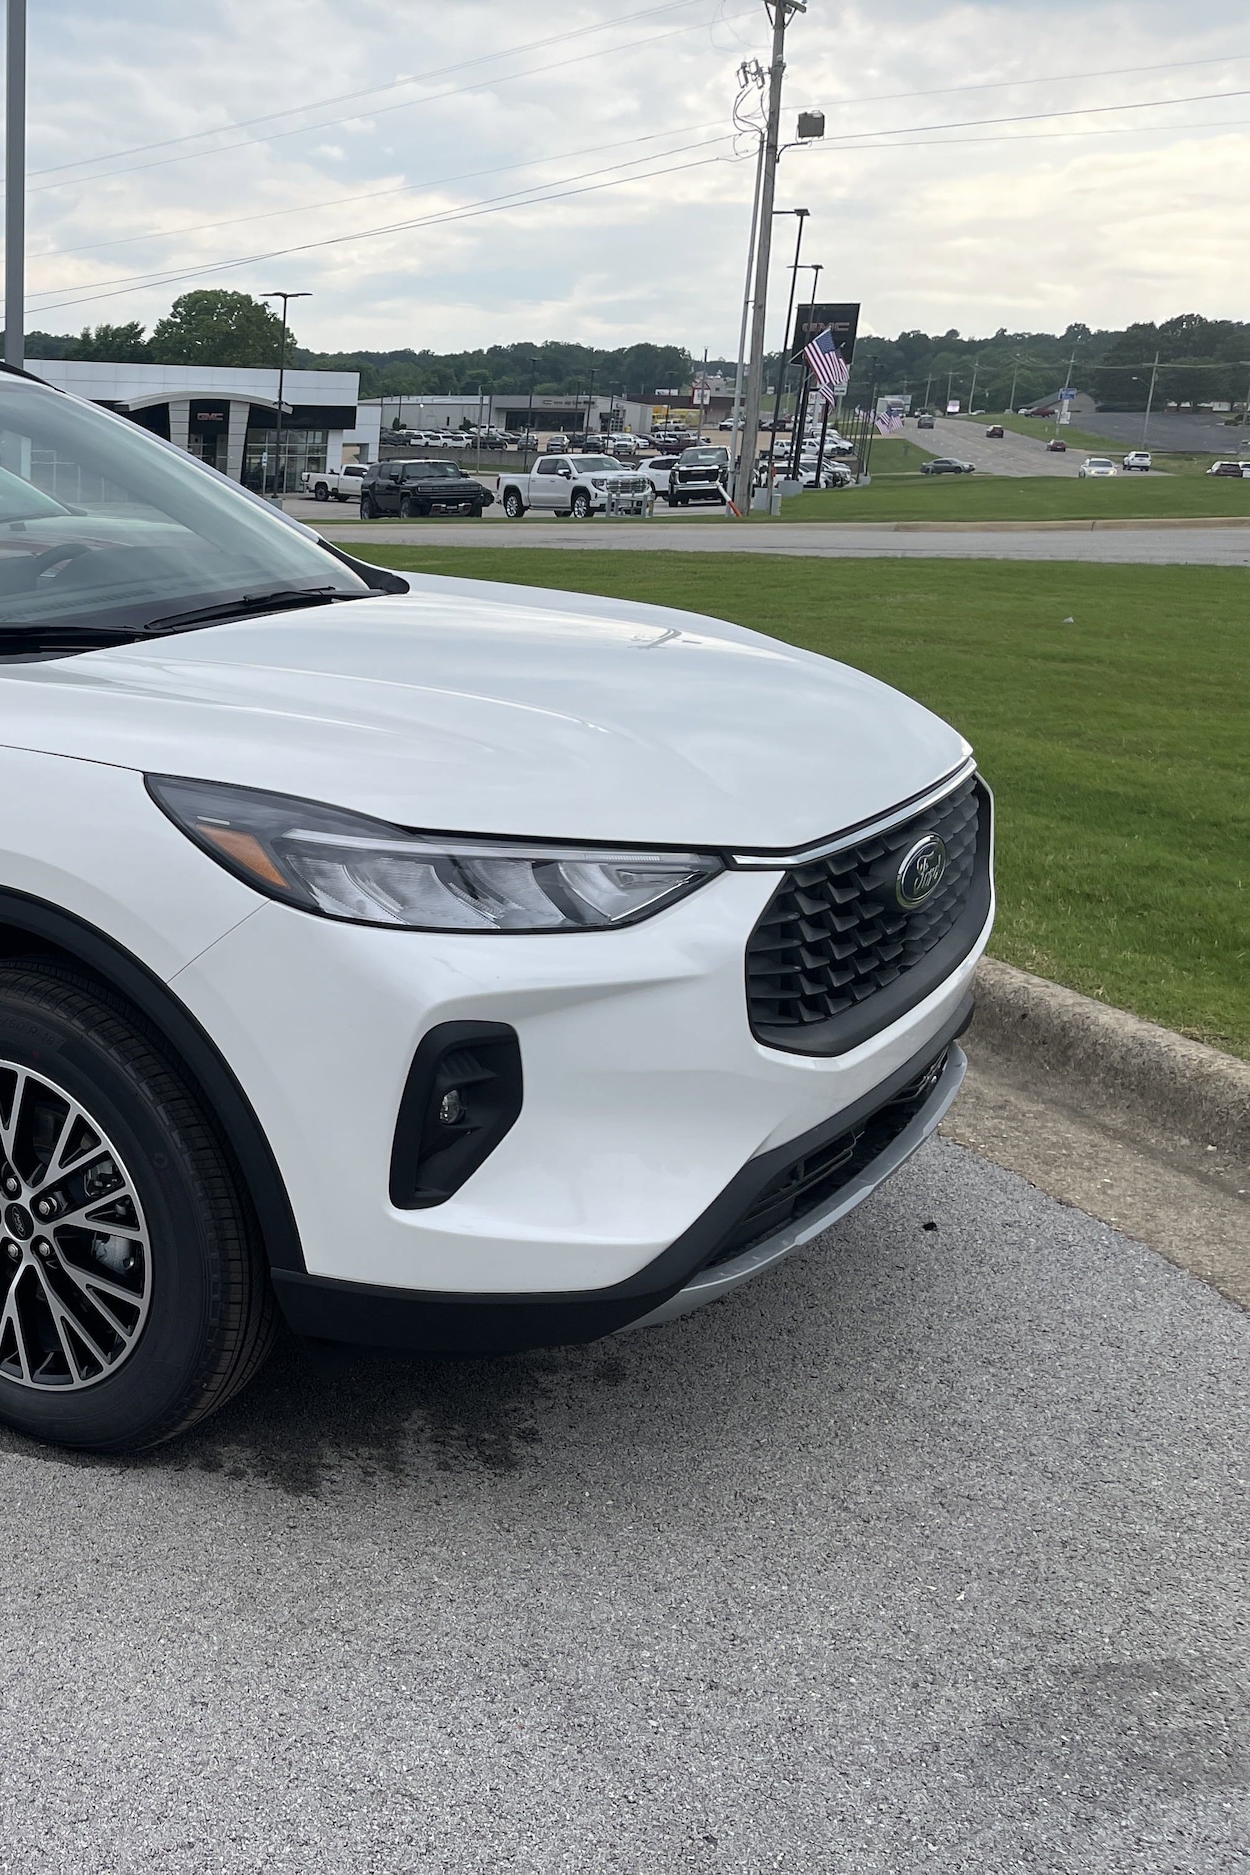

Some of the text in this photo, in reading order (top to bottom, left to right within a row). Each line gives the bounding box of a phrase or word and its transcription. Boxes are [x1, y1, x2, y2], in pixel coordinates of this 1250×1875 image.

[802, 322, 850, 332] GMC
[197, 412, 224, 421] GMC
[914, 850, 942, 892] Ford
